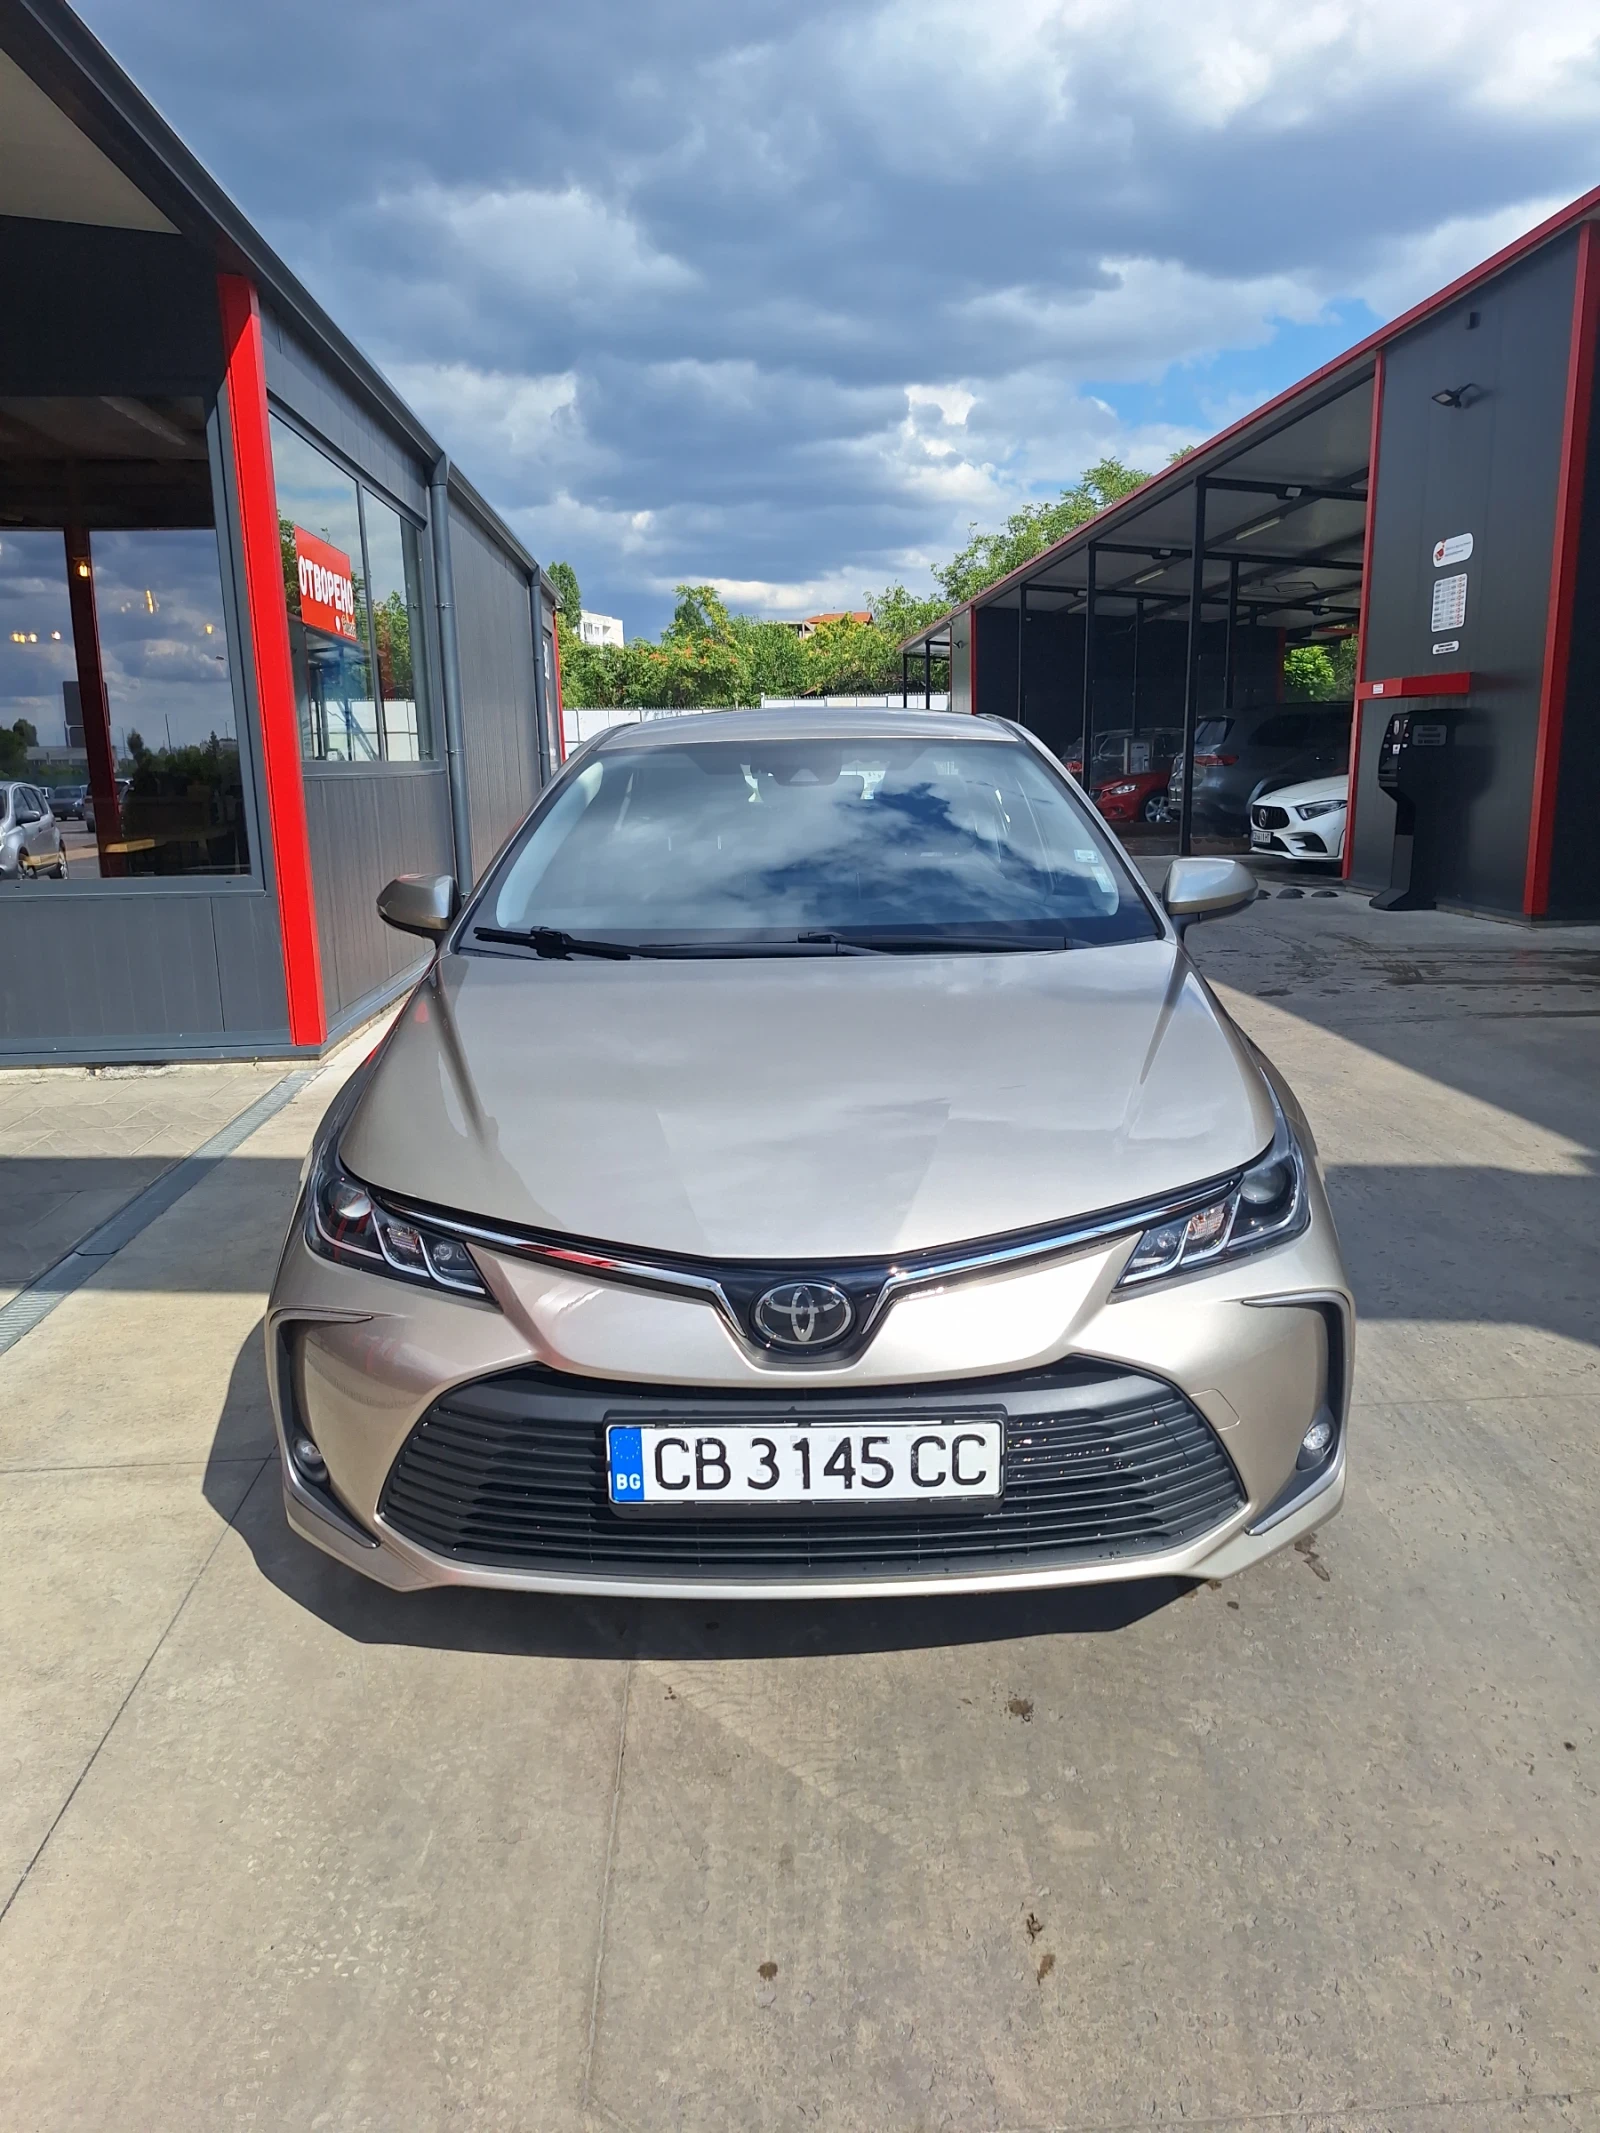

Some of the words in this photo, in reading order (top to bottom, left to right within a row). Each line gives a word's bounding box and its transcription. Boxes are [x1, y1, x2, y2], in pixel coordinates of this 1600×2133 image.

[298, 555, 354, 616] ОТВОРЕНО
[616, 1473, 642, 1490] BG
[654, 1437, 732, 1491] CB
[747, 1436, 895, 1490] 3145
[909, 1434, 988, 1487] CC
